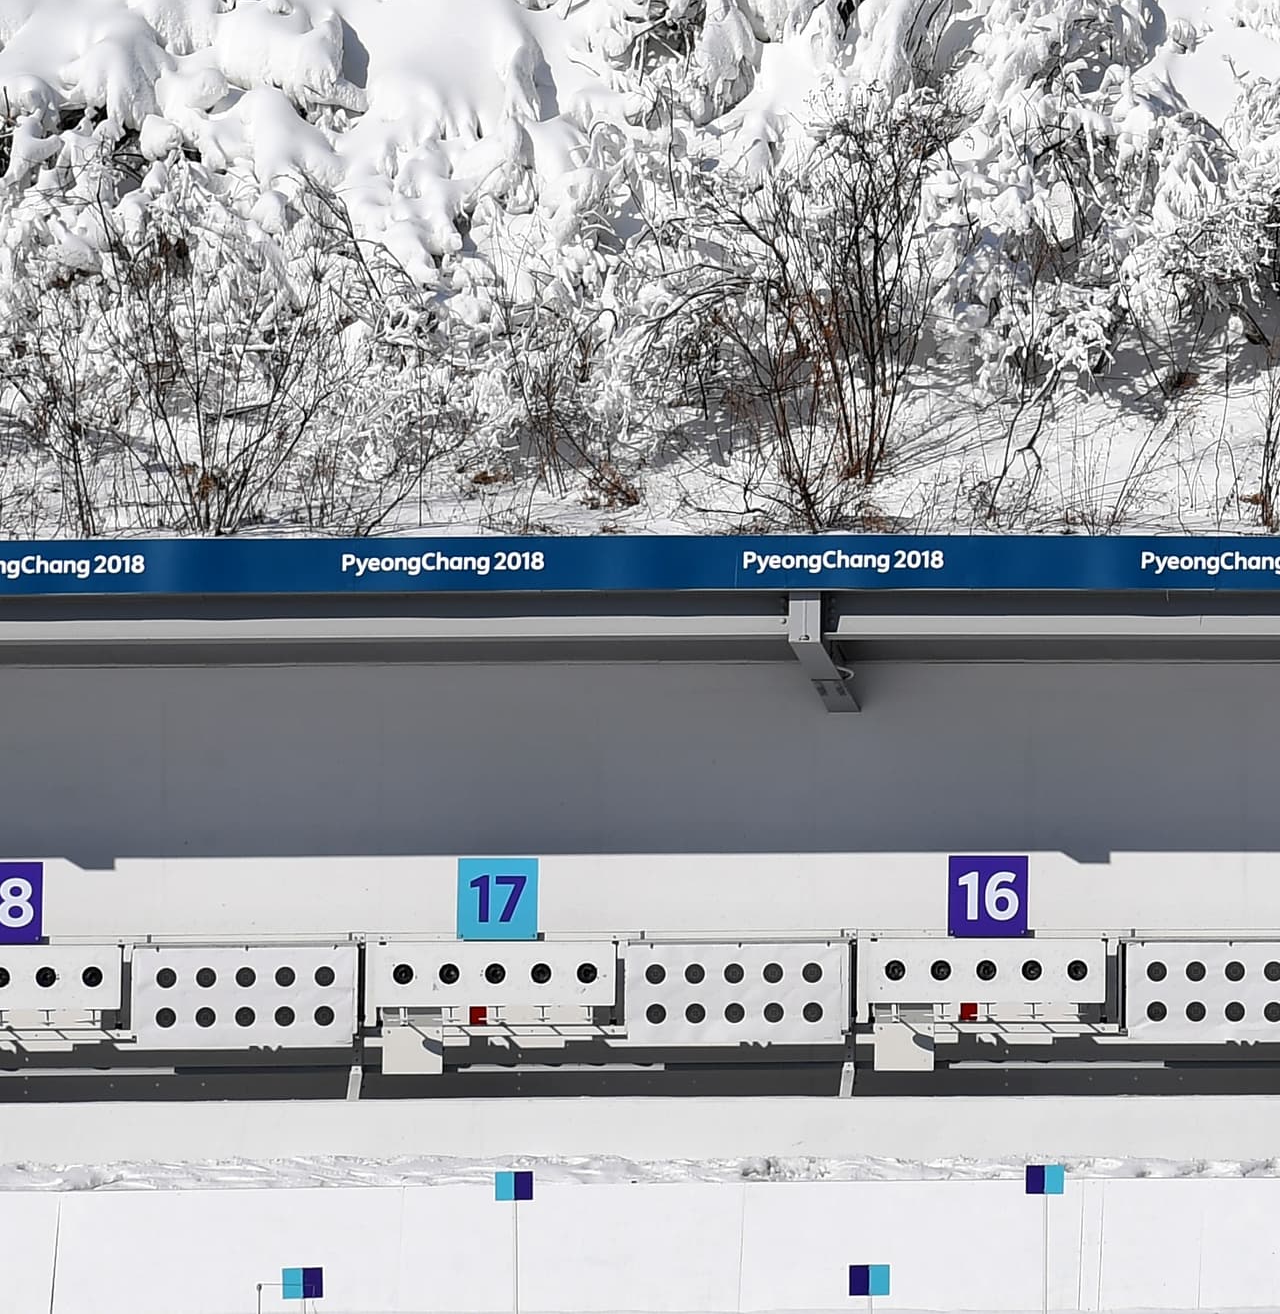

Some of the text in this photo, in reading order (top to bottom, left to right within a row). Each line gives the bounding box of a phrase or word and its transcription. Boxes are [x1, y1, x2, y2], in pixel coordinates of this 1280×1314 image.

[94, 555, 144, 573] 2018
[342, 552, 544, 576] PyeongChang 2018
[744, 550, 943, 573] PyeongChang 2018
[0, 877, 34, 928] 8
[469, 875, 527, 923] 17
[958, 871, 1019, 921] 16
